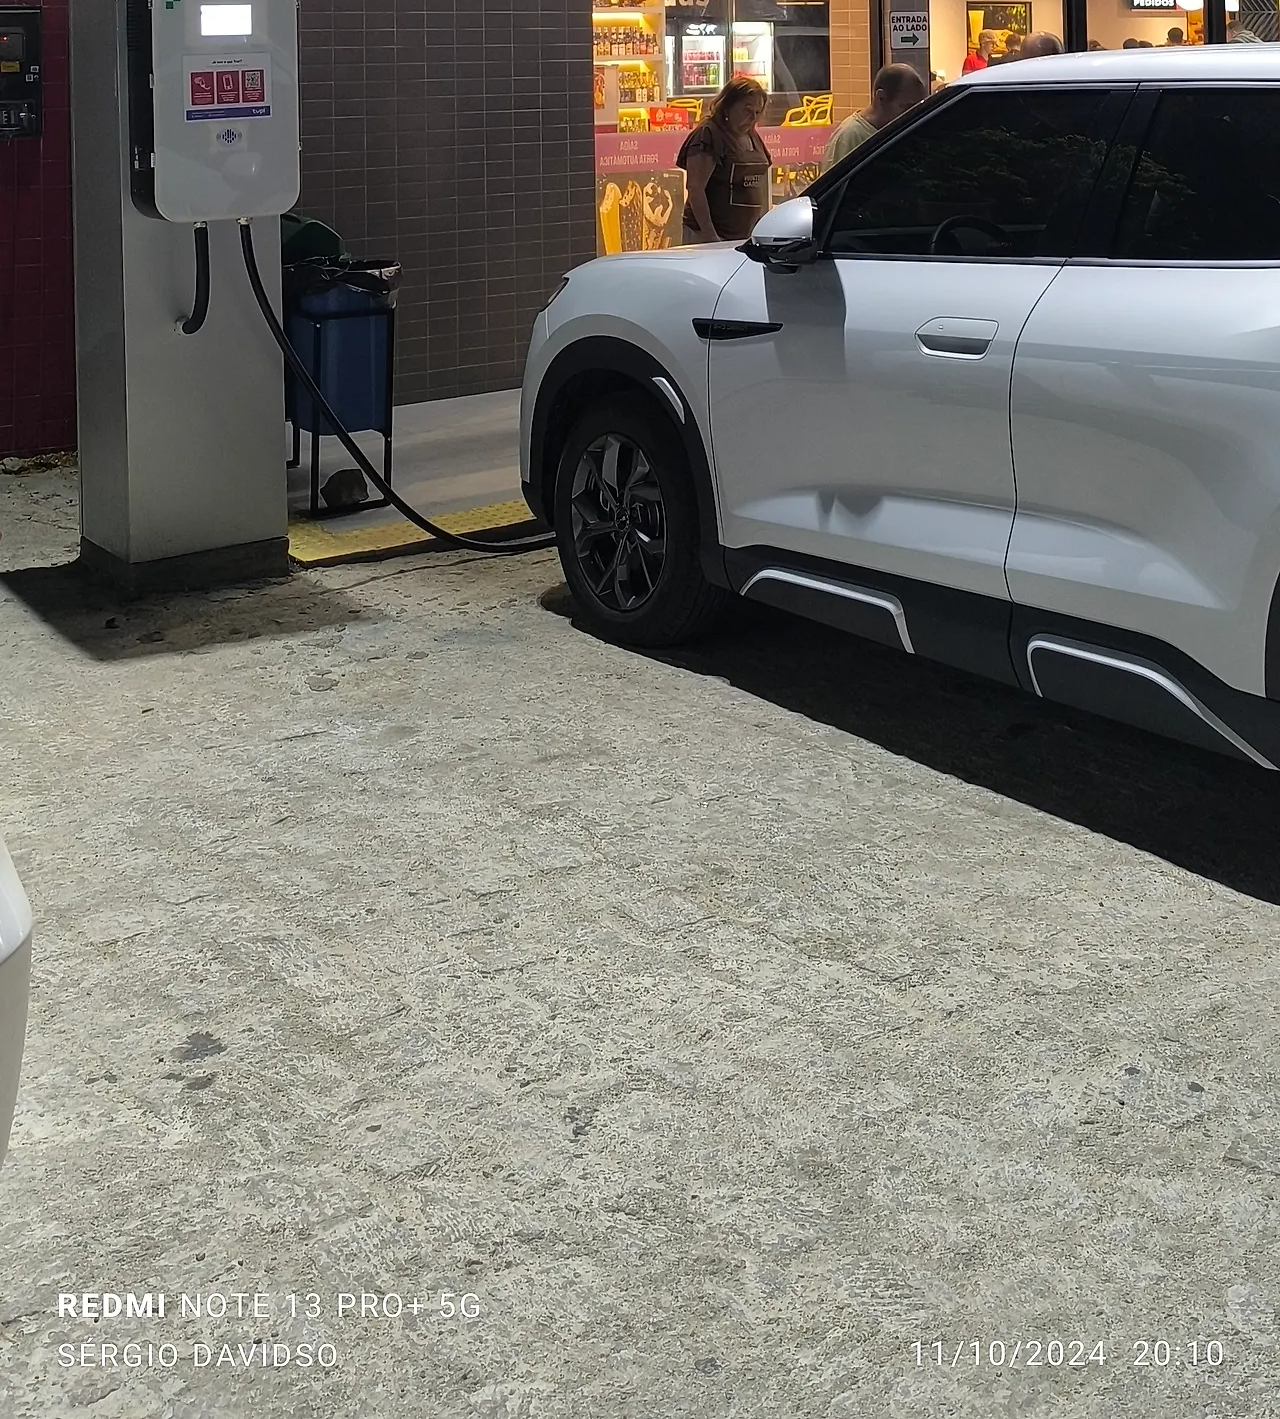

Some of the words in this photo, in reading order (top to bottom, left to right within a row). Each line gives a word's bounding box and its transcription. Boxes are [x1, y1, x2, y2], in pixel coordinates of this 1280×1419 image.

[891, 15, 928, 24] ENTRADA
[892, 24, 904, 32] AO
[906, 24, 928, 32] LADO
